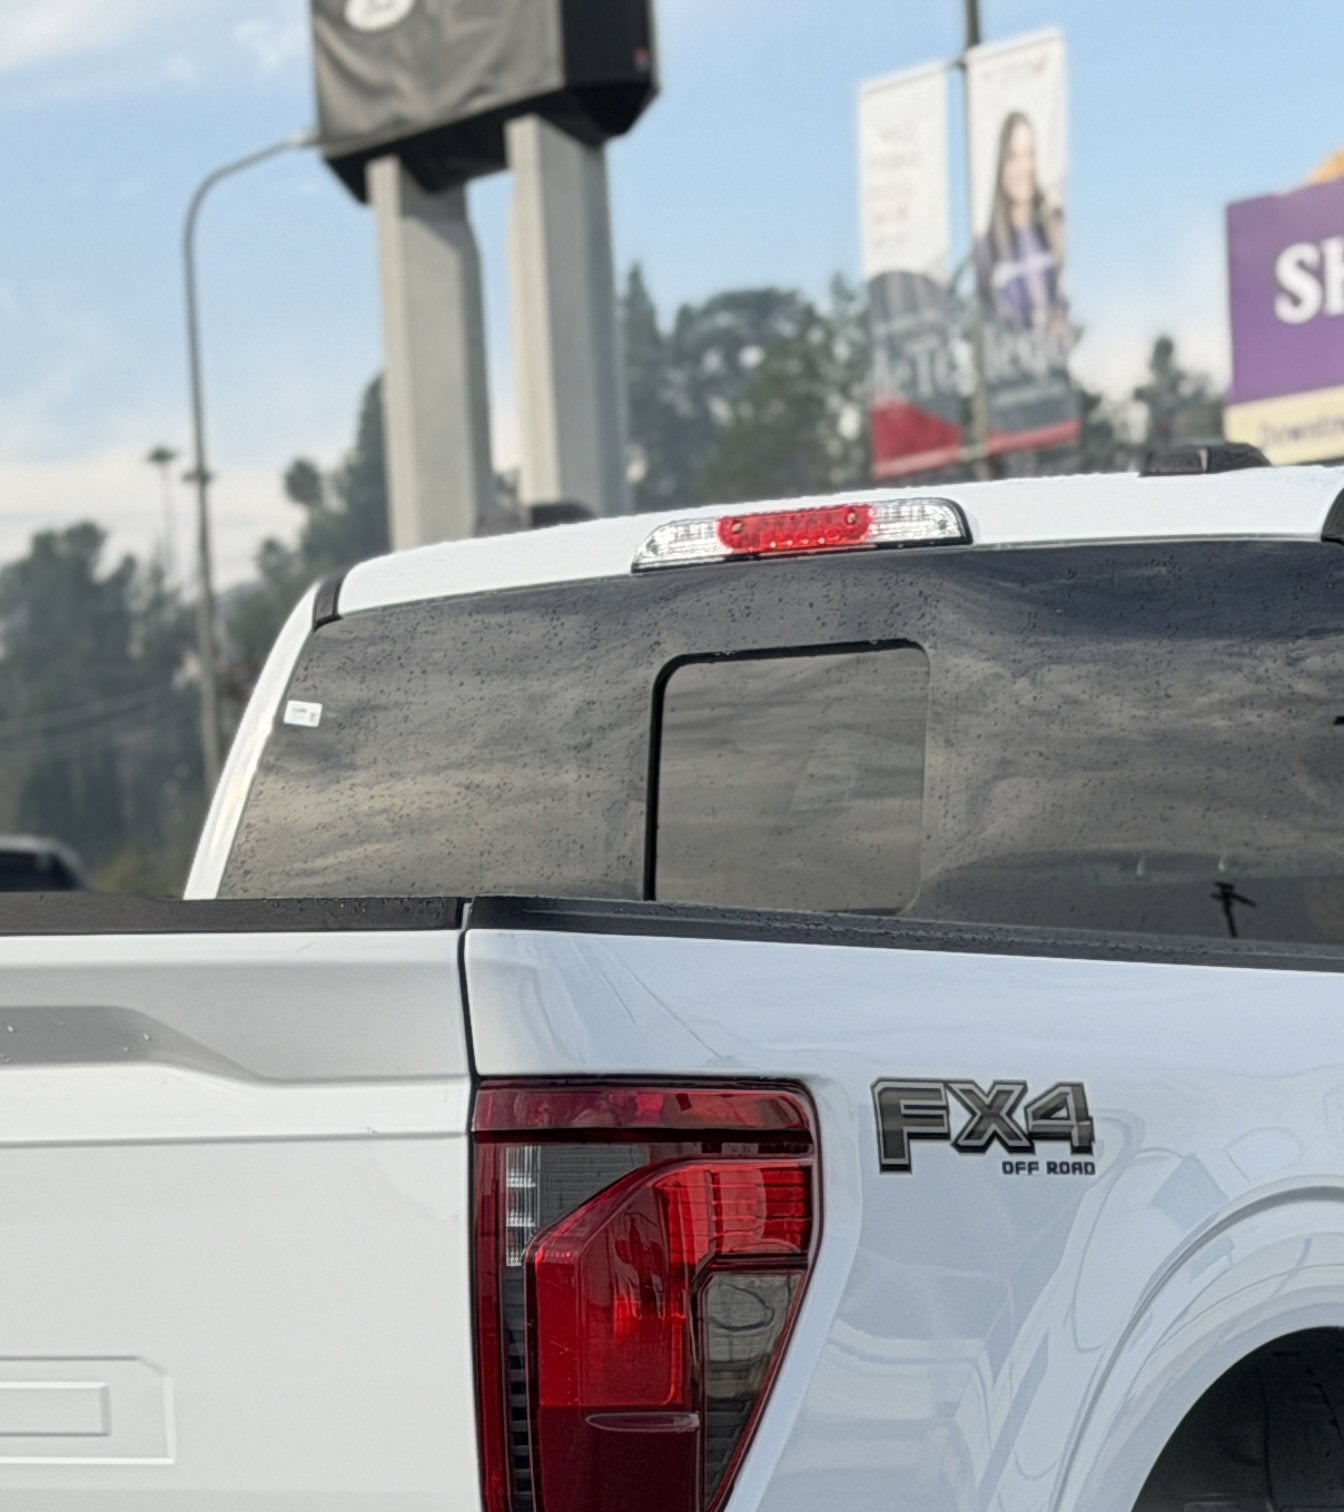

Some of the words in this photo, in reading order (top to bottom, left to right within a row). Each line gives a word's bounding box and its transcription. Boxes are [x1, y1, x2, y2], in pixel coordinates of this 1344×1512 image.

[870, 1076, 1096, 1175] FX4
[1002, 1160, 1040, 1175] OFF
[1046, 1161, 1096, 1175] ROAD
